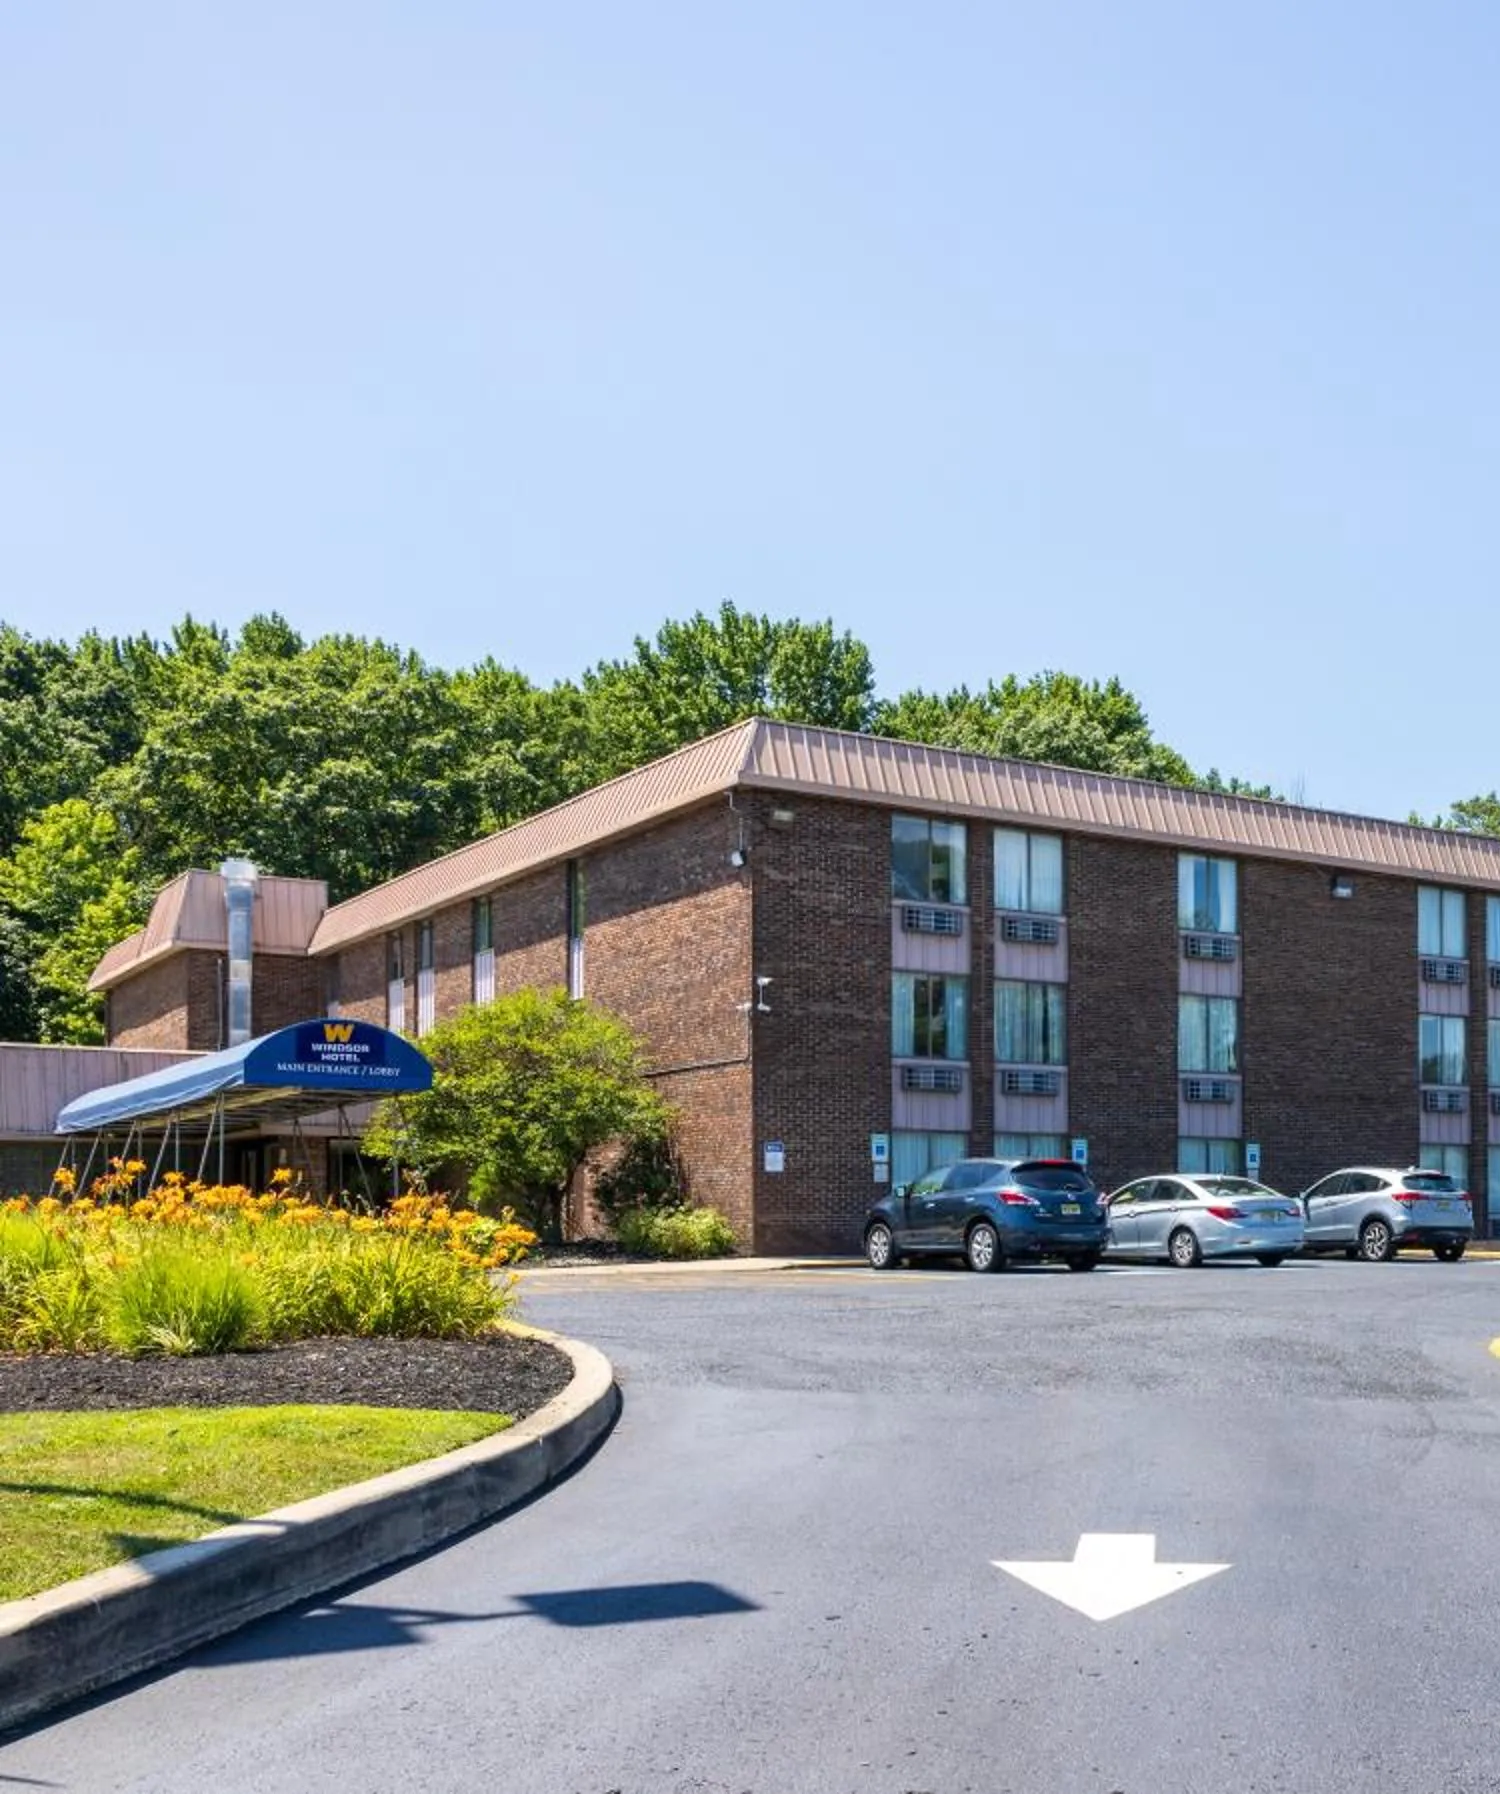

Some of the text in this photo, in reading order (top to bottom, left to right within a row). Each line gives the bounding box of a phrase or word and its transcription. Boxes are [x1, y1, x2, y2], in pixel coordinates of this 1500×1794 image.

[323, 1023, 355, 1042] W
[311, 1043, 370, 1053] WINDSOR
[321, 1053, 360, 1062] HOTEL
[276, 1062, 305, 1072] MAIN
[307, 1063, 361, 1076] ENTRANCE
[369, 1066, 401, 1077] LOBBY
